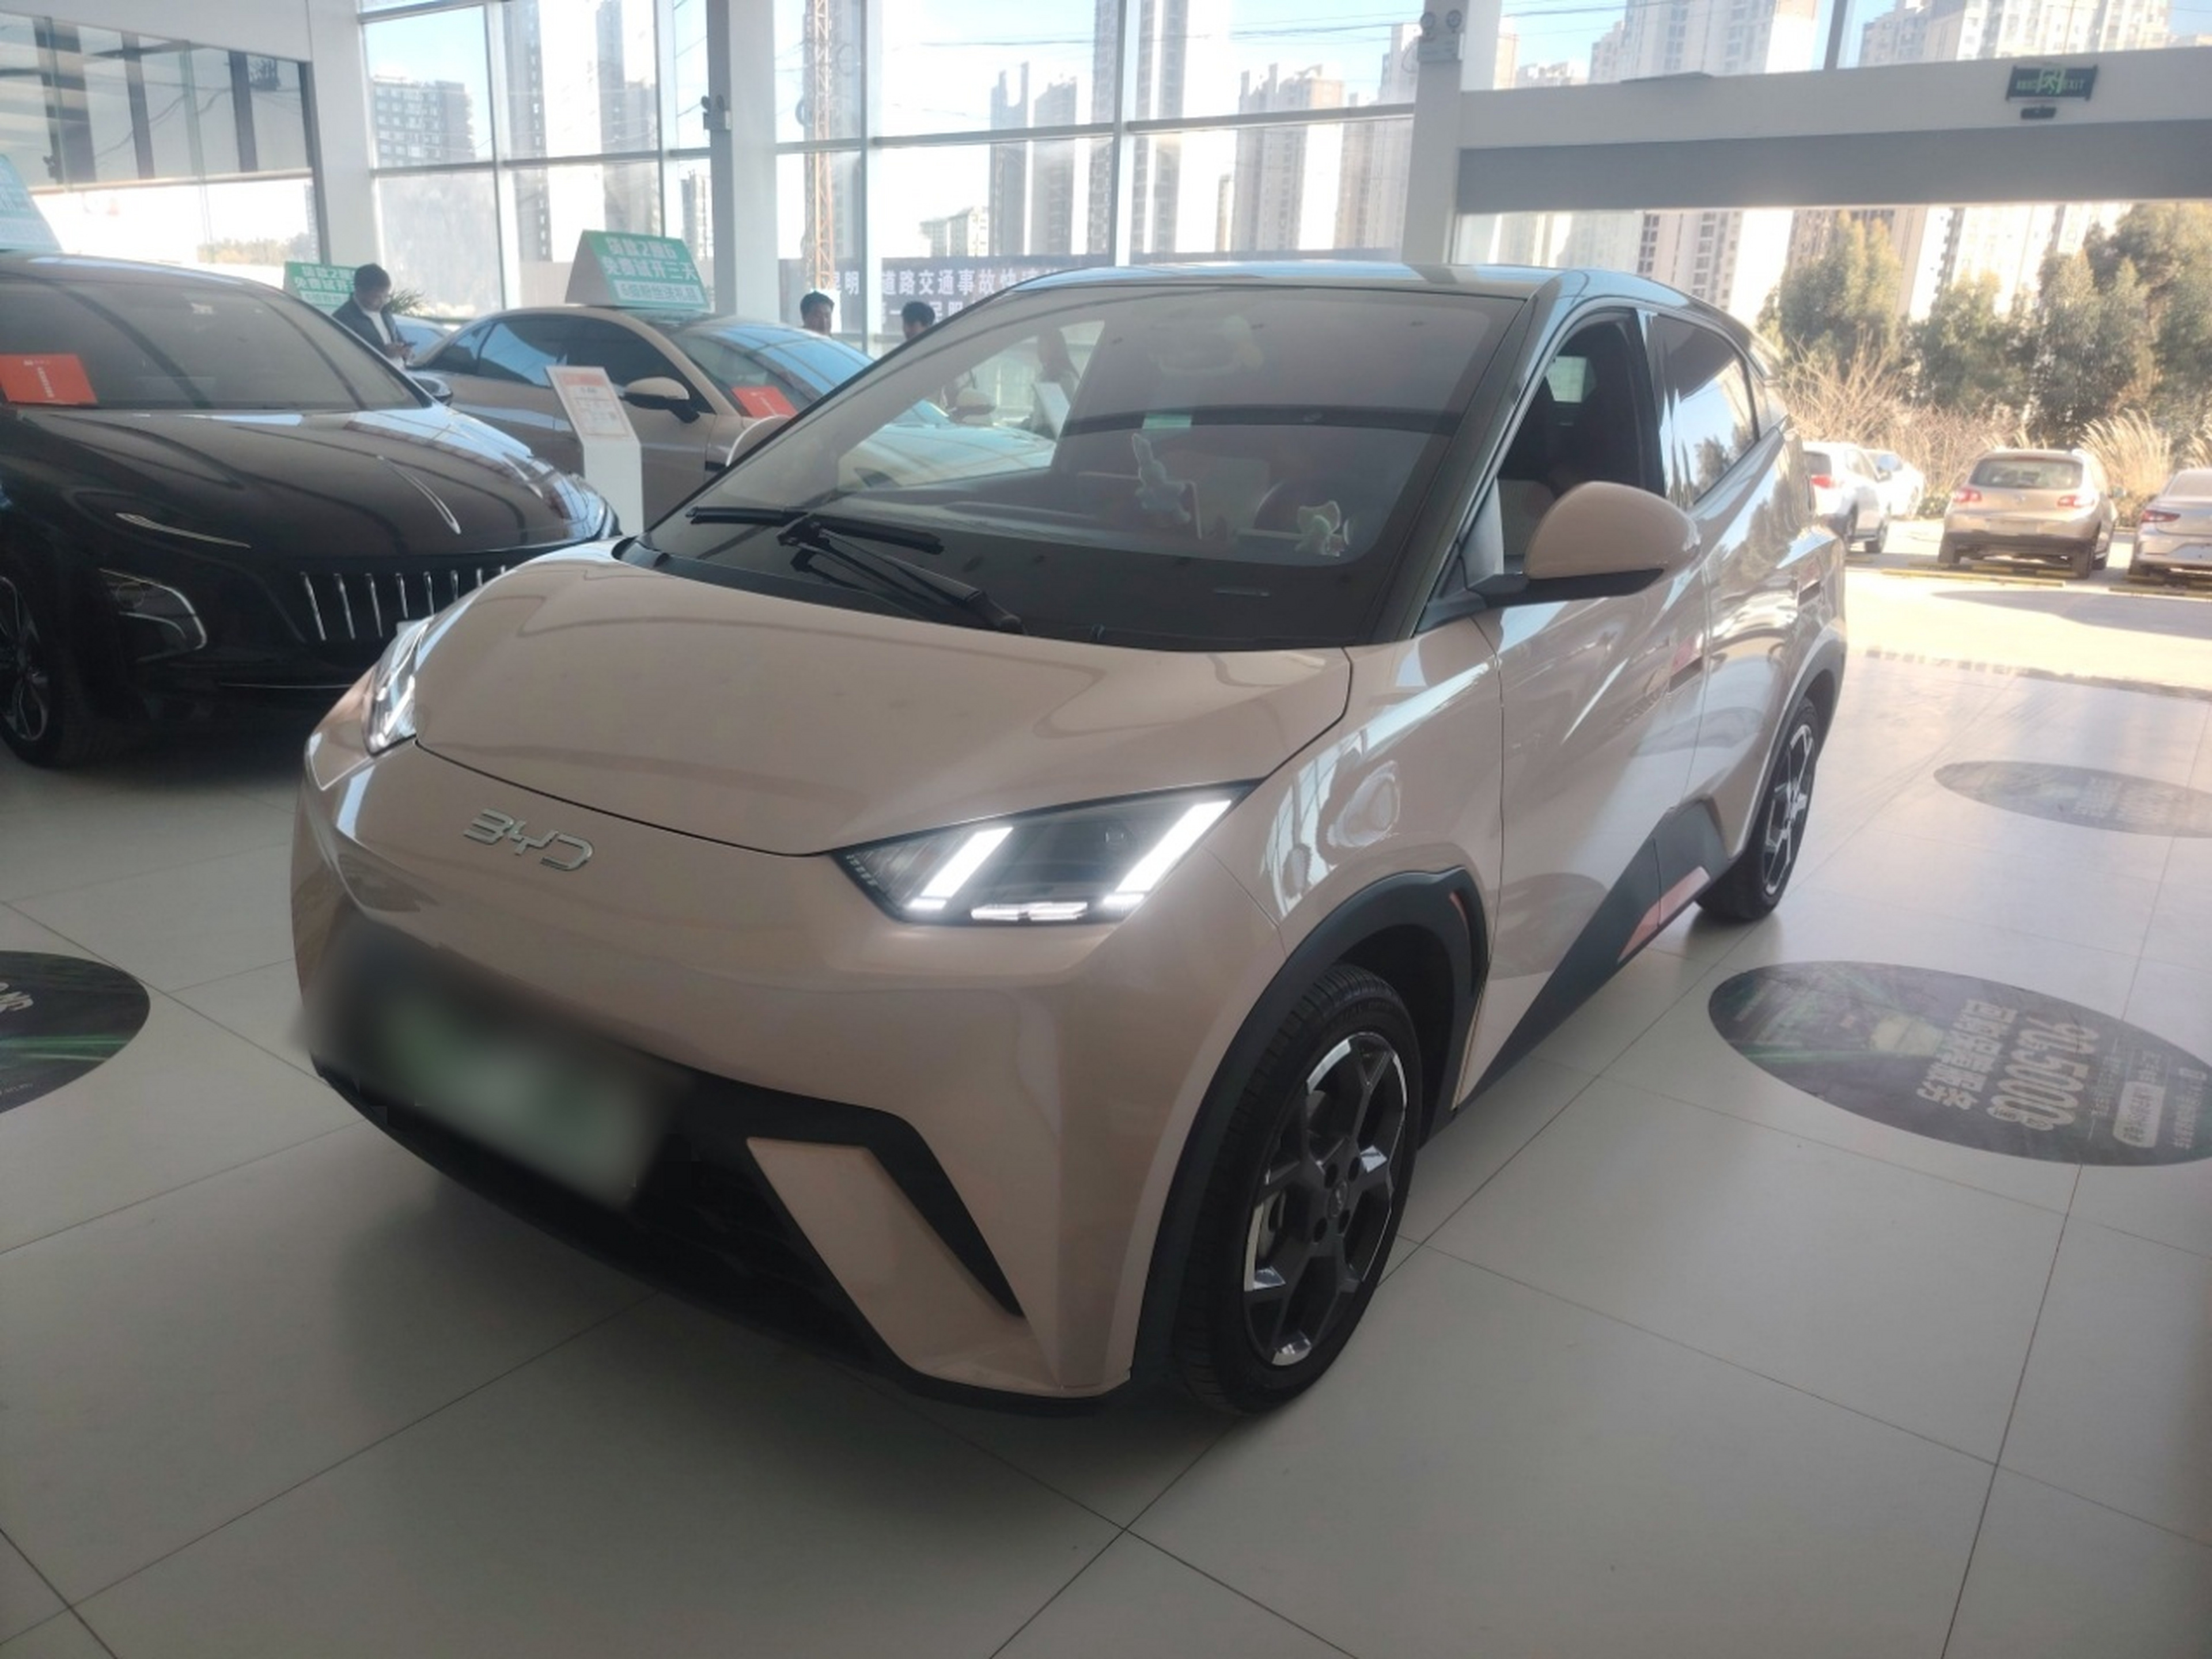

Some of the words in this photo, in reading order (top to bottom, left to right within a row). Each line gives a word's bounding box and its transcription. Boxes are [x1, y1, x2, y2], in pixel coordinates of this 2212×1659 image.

[602, 256, 699, 281] 免费试开三天
[463, 808, 594, 872] BYD
